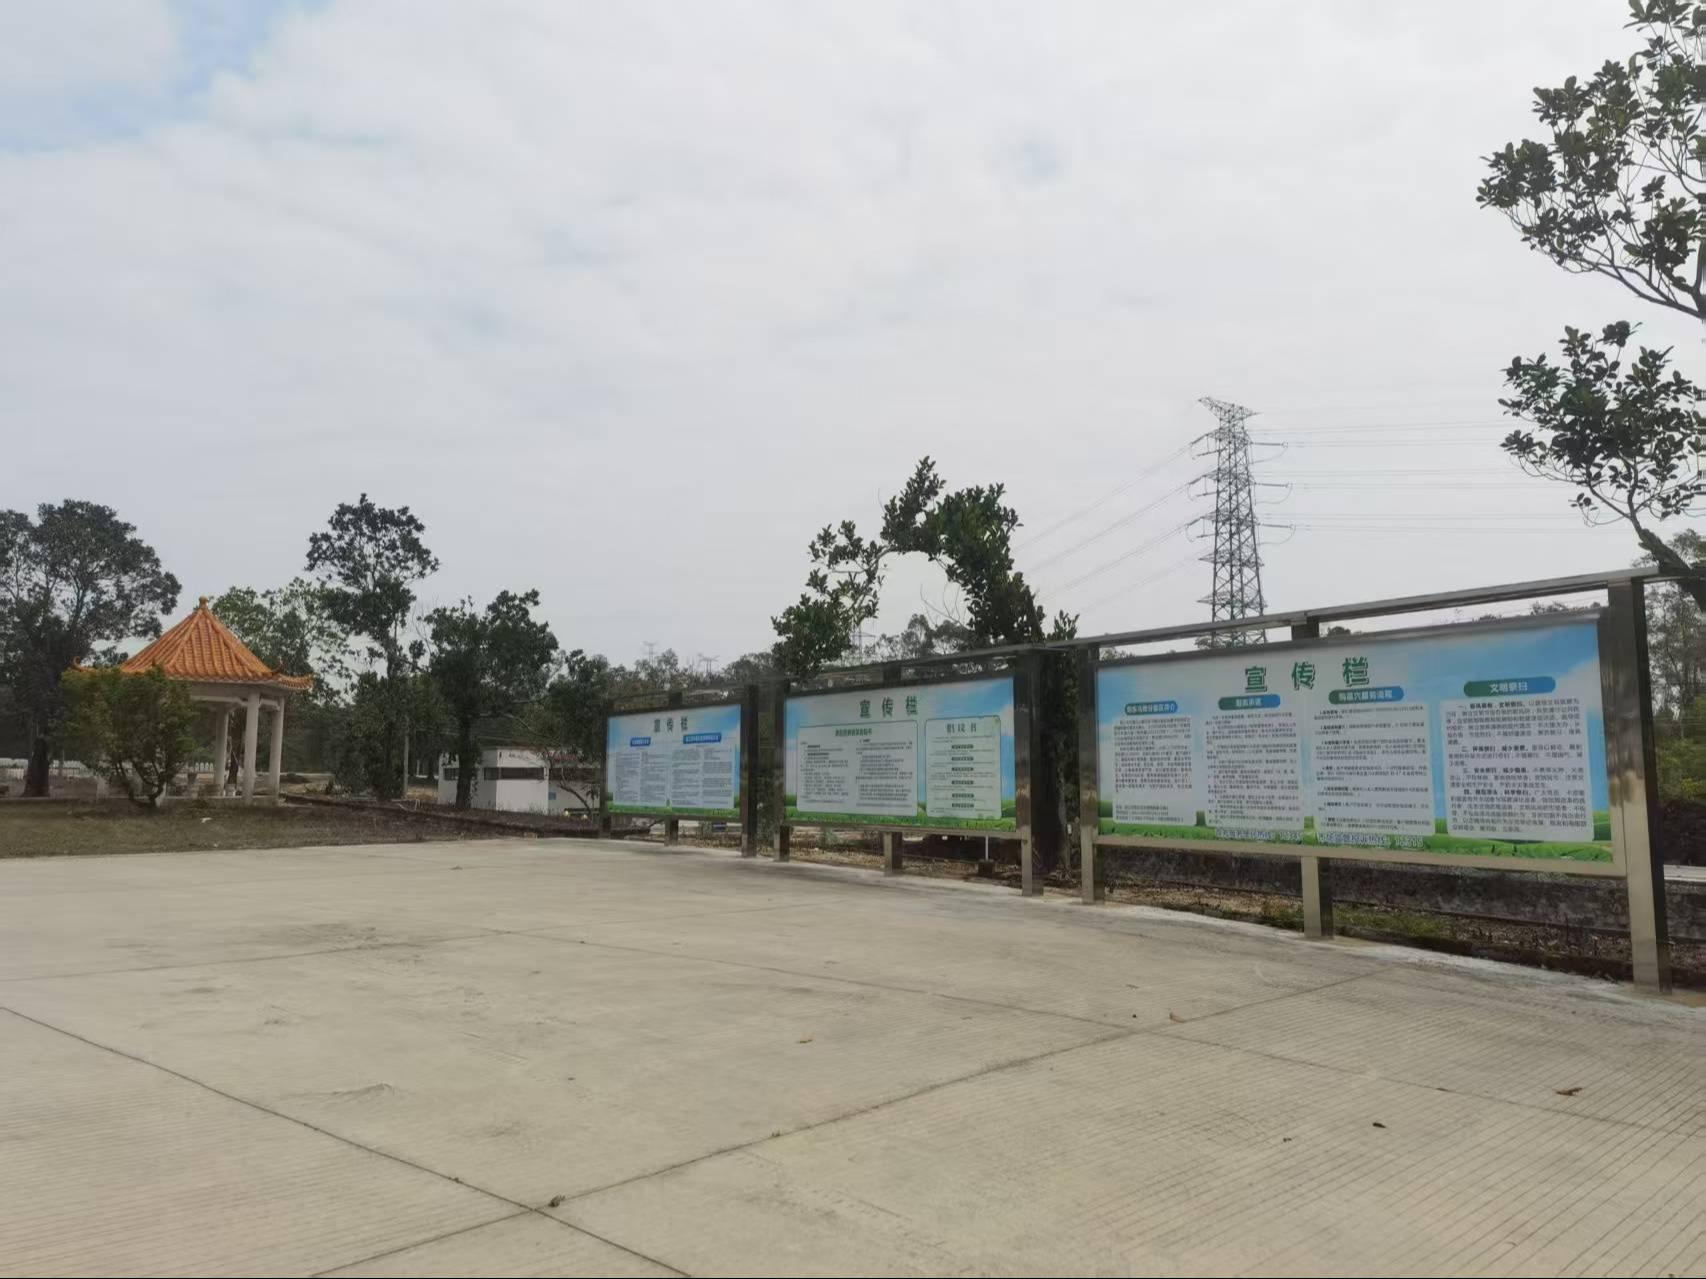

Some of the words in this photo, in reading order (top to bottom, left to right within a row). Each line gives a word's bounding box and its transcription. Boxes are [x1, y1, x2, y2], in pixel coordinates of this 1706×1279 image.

[1244, 656, 1369, 692] 宣传栏
[860, 695, 918, 719] 宣传栏
